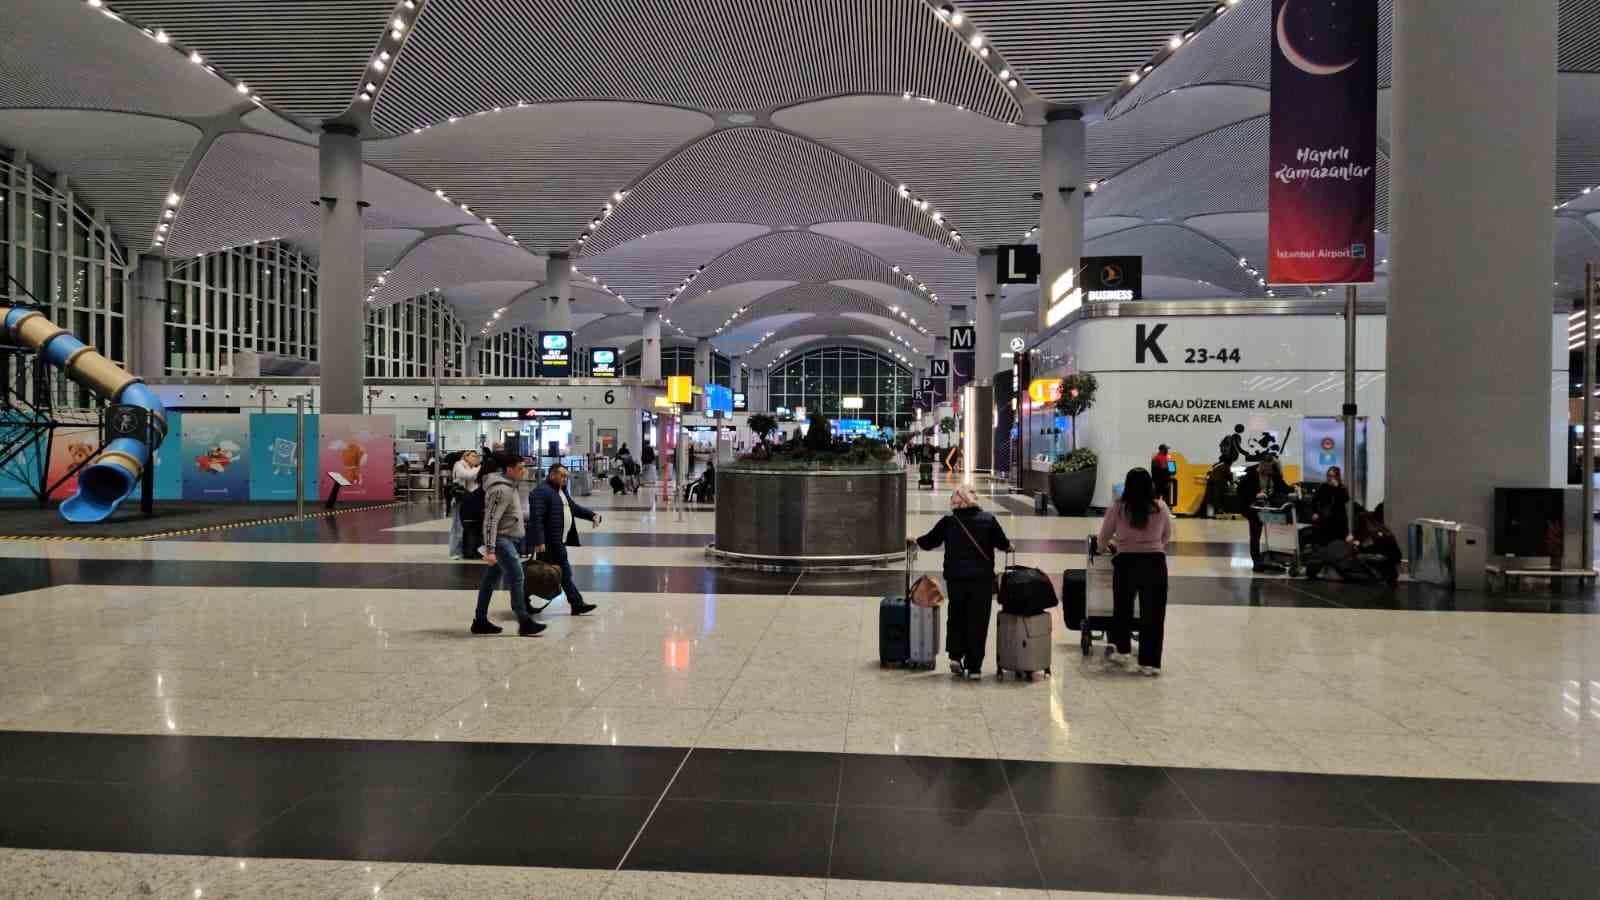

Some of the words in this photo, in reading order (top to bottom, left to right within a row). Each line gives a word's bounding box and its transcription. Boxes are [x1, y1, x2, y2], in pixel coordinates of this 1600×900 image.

[1297, 146, 1349, 166] Hayırlı
[1275, 163, 1372, 183] Ramazanlar
[1318, 247, 1350, 258] Airport
[1008, 249, 1026, 279] L
[1088, 290, 1133, 300] BUSINESS
[952, 329, 972, 347] M
[1135, 323, 1169, 364] K
[1184, 347, 1241, 364] 23-44
[934, 362, 945, 375] N
[923, 379, 930, 389] P
[604, 389, 615, 405] 6
[915, 391, 922, 400] R
[1148, 399, 1184, 409] BAGAJ
[1186, 397, 1255, 409] DÜZENLEME
[1256, 399, 1293, 409] ALANI
[1148, 414, 1190, 424] REPACK
[1192, 414, 1222, 424] AREA
